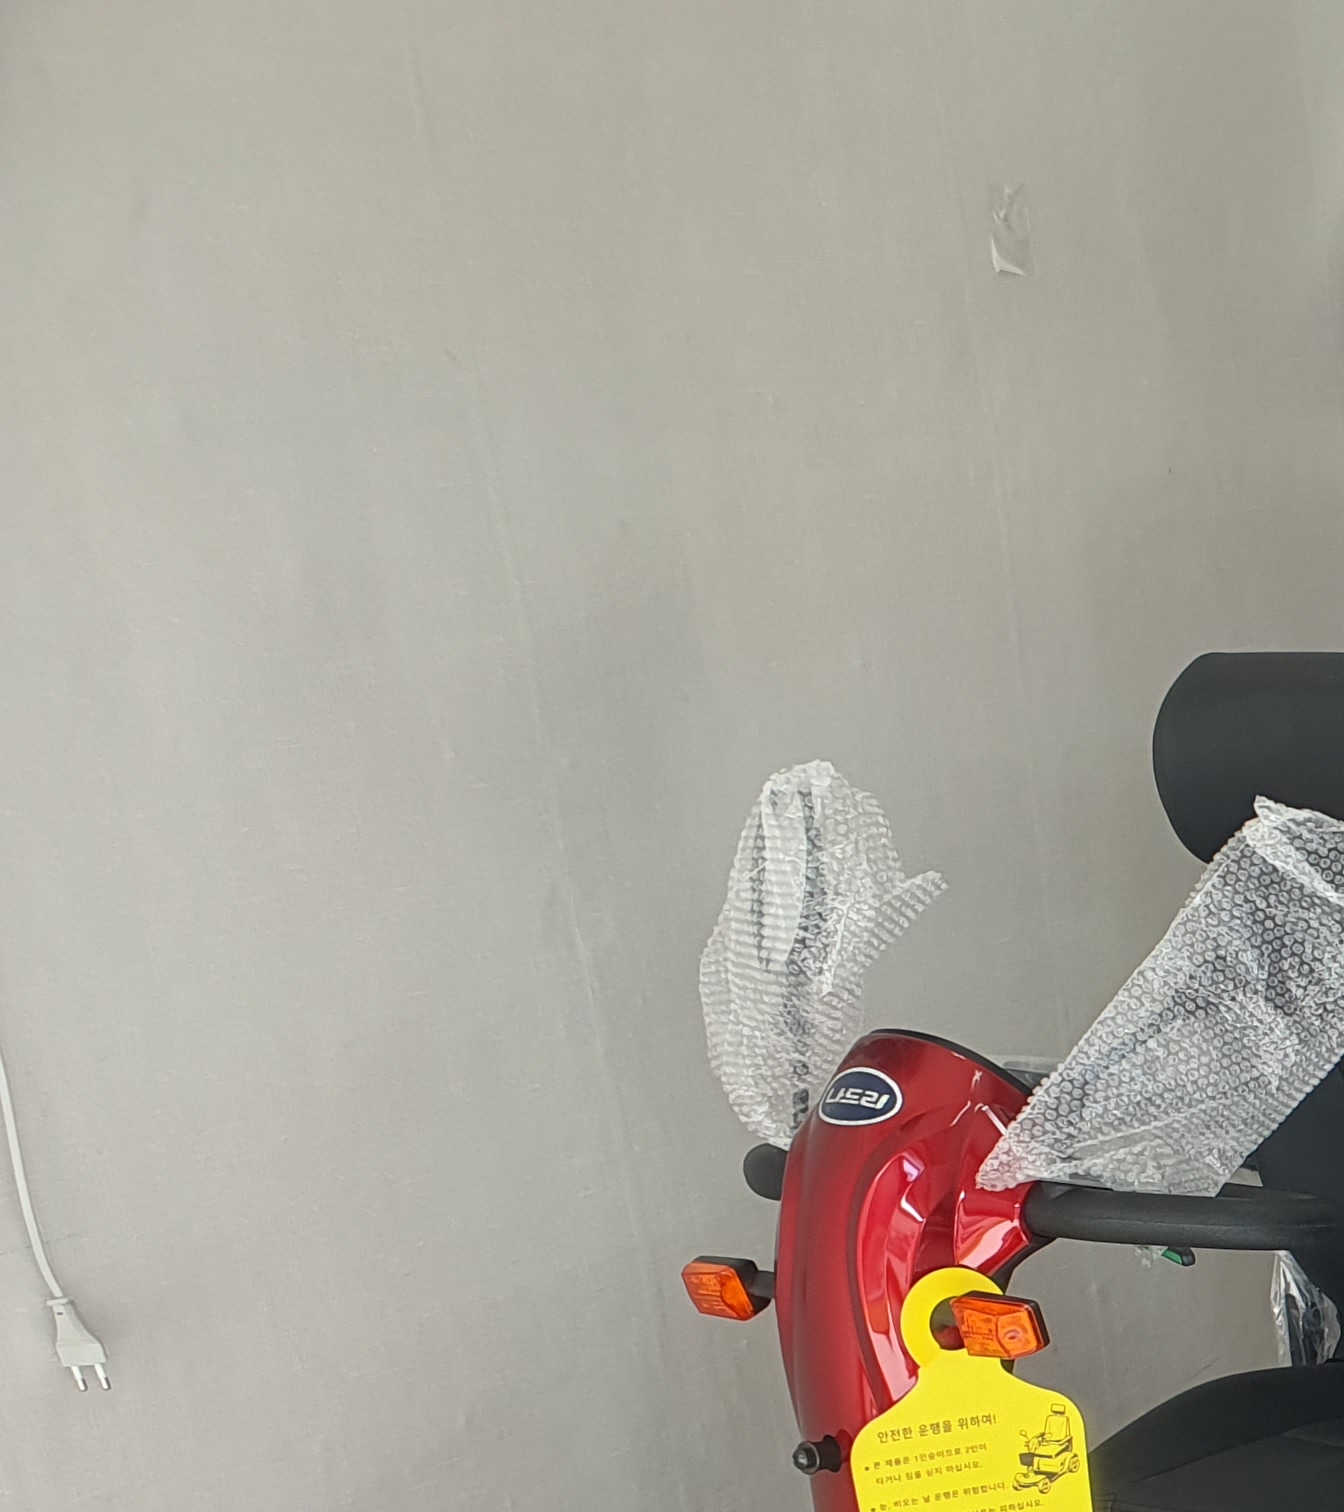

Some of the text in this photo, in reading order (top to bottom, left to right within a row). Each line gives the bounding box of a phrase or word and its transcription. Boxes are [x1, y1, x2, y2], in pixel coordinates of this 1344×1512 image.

[825, 1087, 891, 1110] 나드리
[877, 1413, 997, 1444] 안전한 운행을 위하여!
